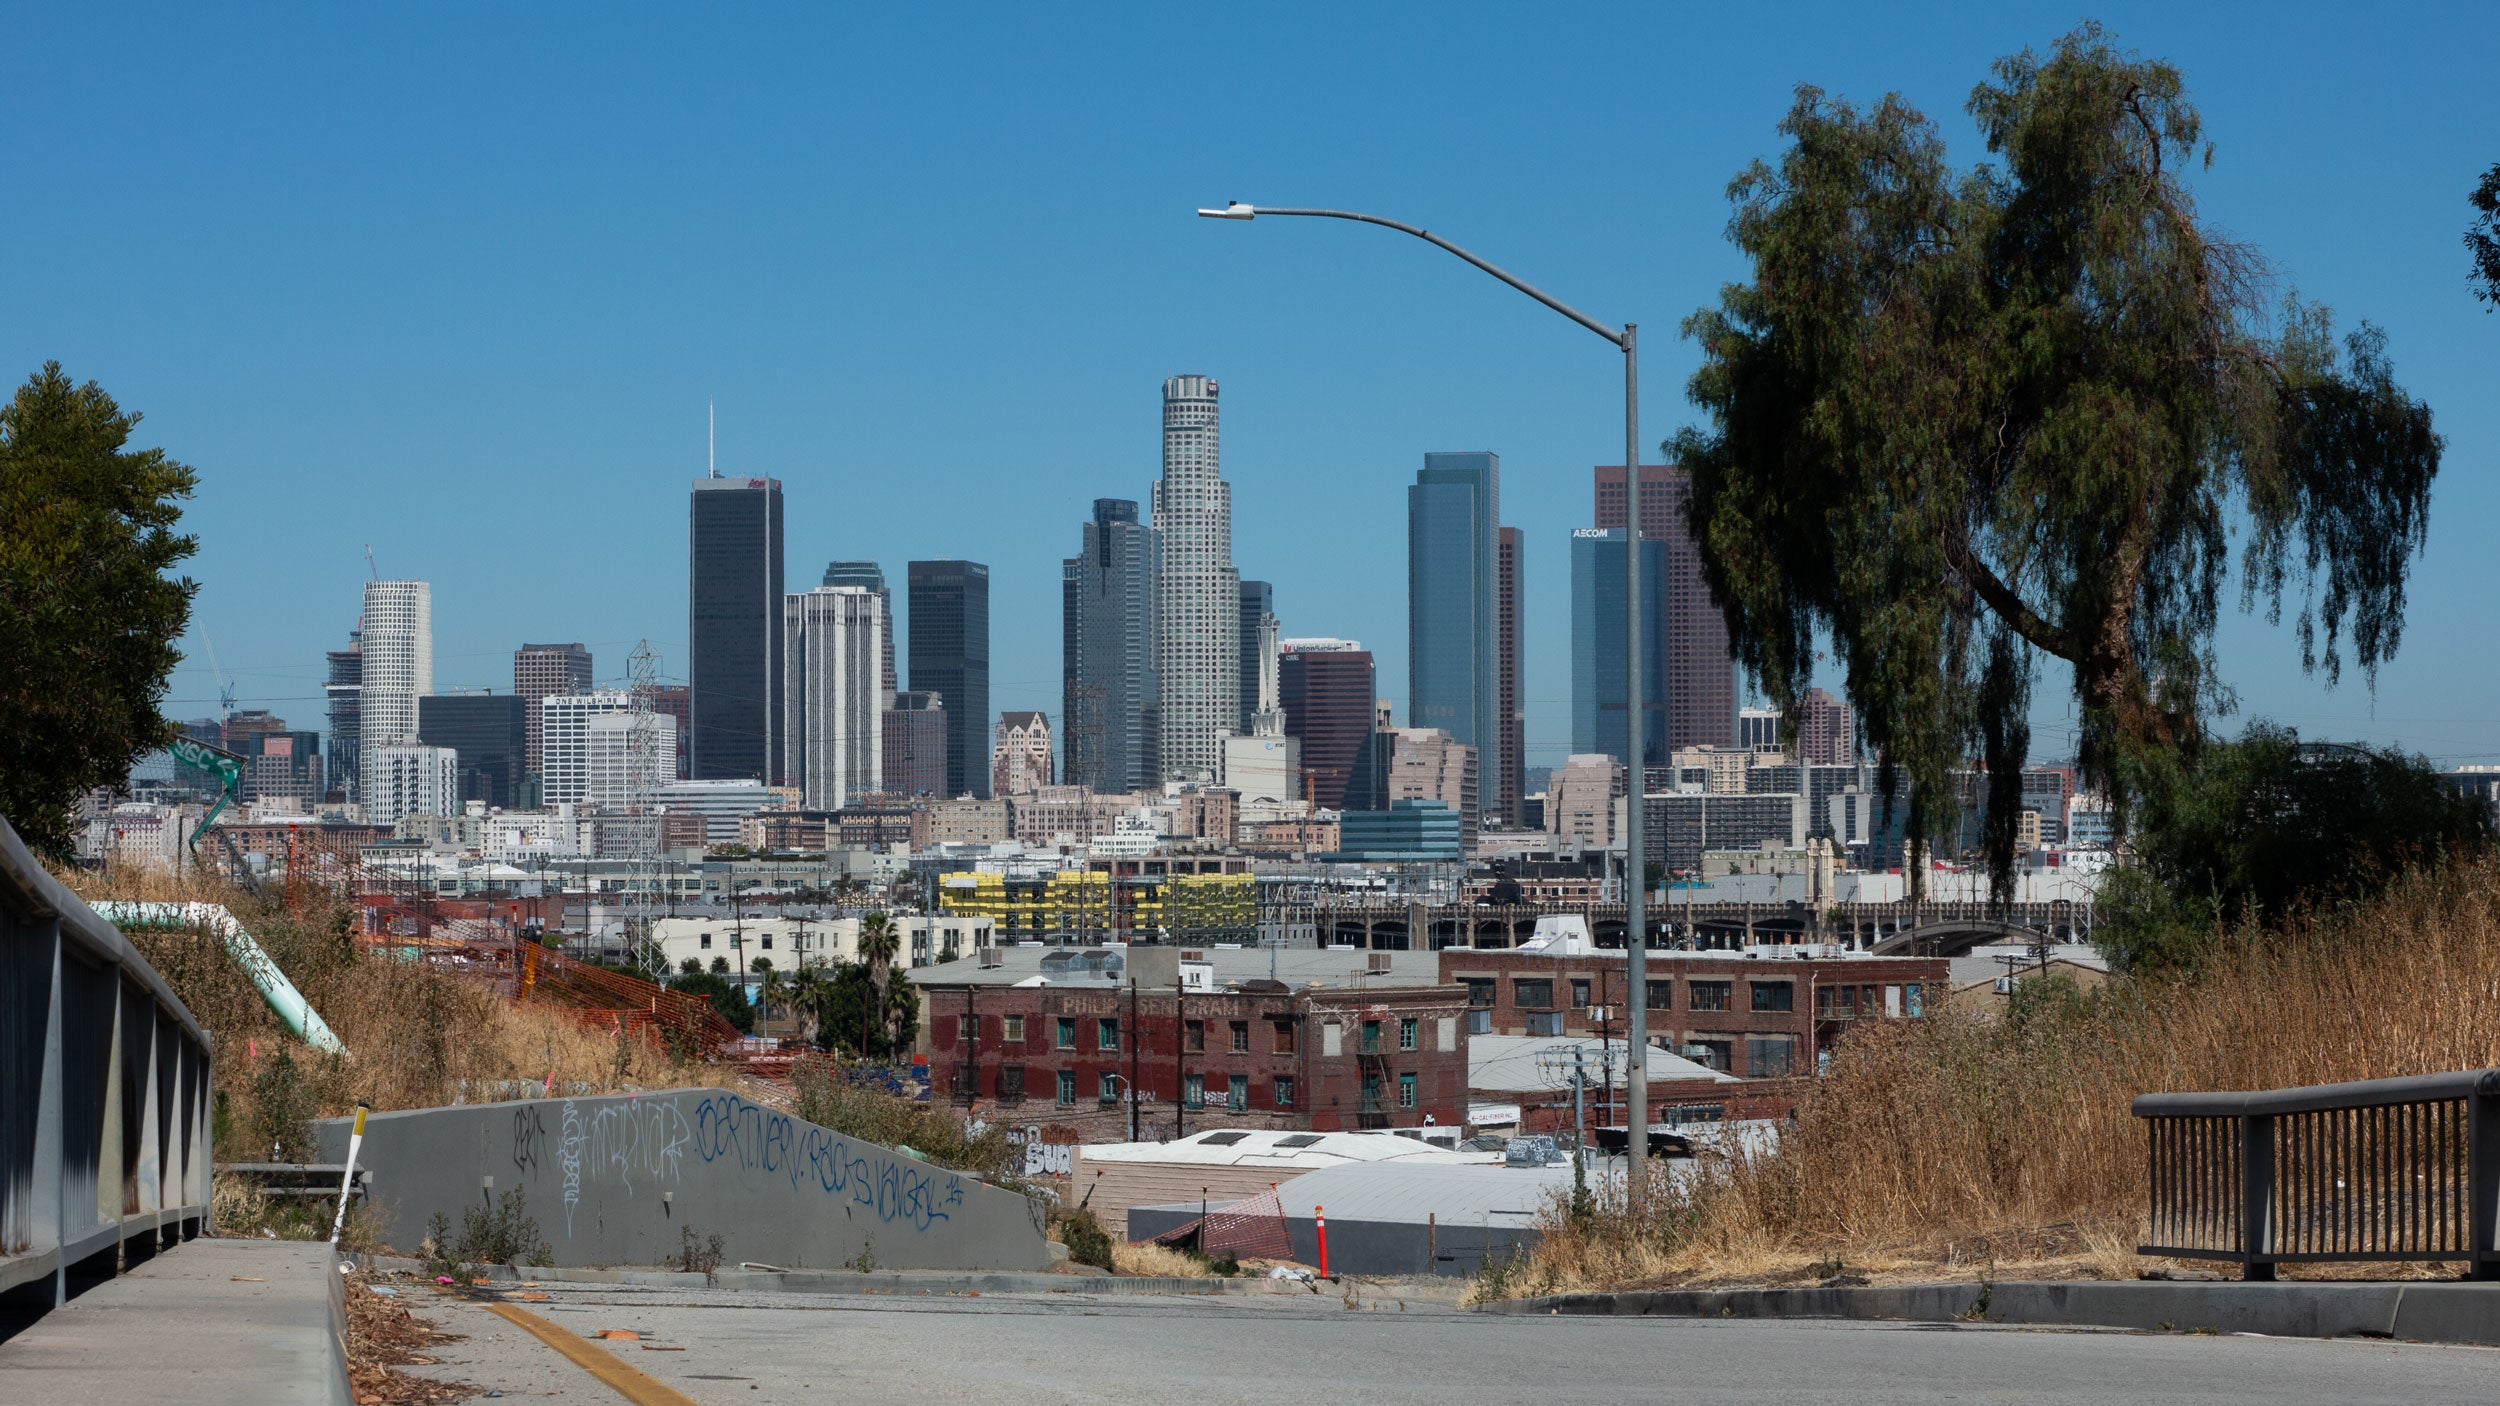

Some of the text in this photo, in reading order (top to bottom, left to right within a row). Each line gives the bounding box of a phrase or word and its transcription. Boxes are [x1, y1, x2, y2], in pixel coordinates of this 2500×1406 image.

[1572, 528, 1608, 538] AECOM
[555, 697, 618, 705] ONE WILSHIRE
[1062, 997, 1118, 1014] PHILIP
